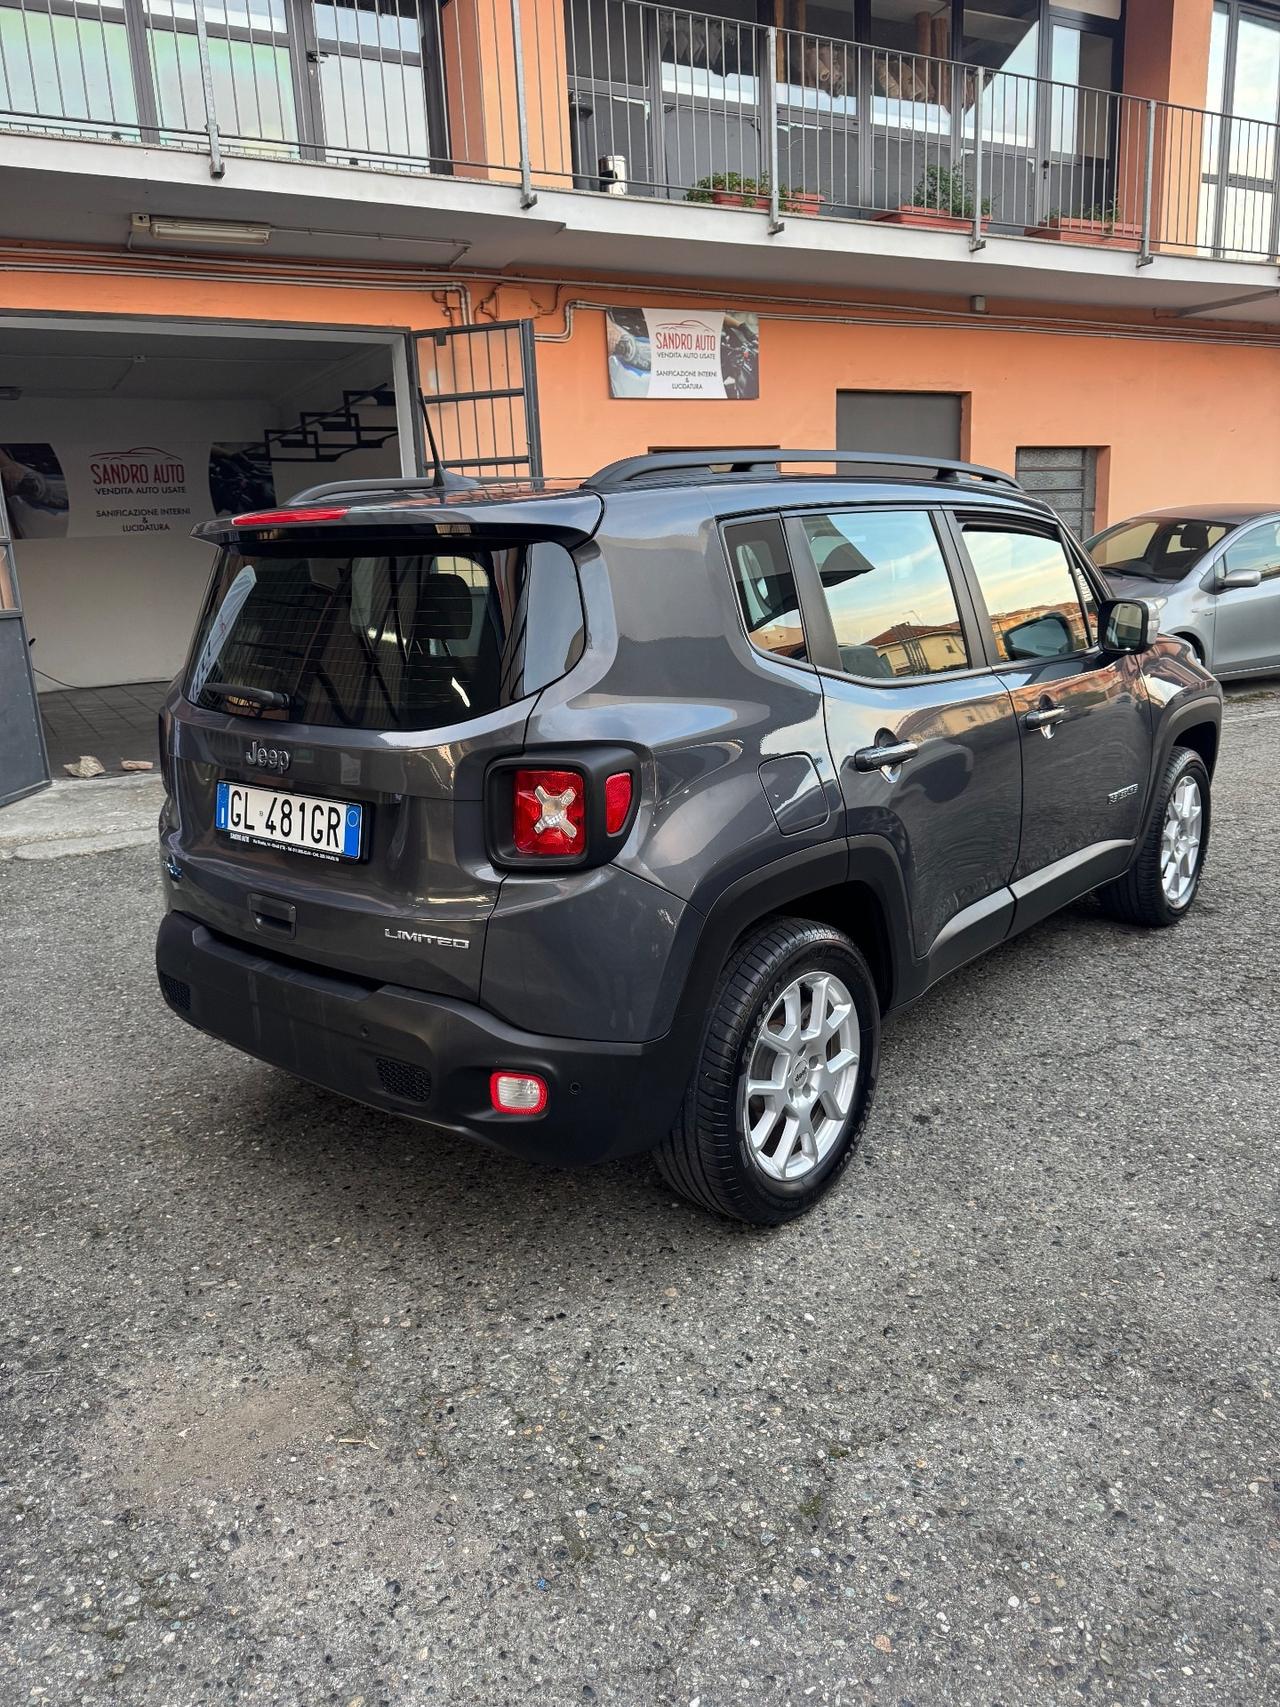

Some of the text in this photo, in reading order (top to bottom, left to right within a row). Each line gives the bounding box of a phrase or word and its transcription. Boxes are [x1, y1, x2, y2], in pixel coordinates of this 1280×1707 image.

[656, 332, 716, 351] SANDRO AUTO
[657, 351, 682, 359] VENDITA
[90, 464, 185, 485] SANDRO AUTO
[95, 486, 186, 495] VENDITA AUTO USATE
[96, 507, 191, 518] SANIFICAZIONE INTERNI
[142, 516, 148, 524] &
[122, 523, 170, 532] LUCIDATURA
[245, 740, 291, 774] Jeep
[230, 790, 341, 848] GL 481GR
[384, 928, 470, 949] LIMITED
